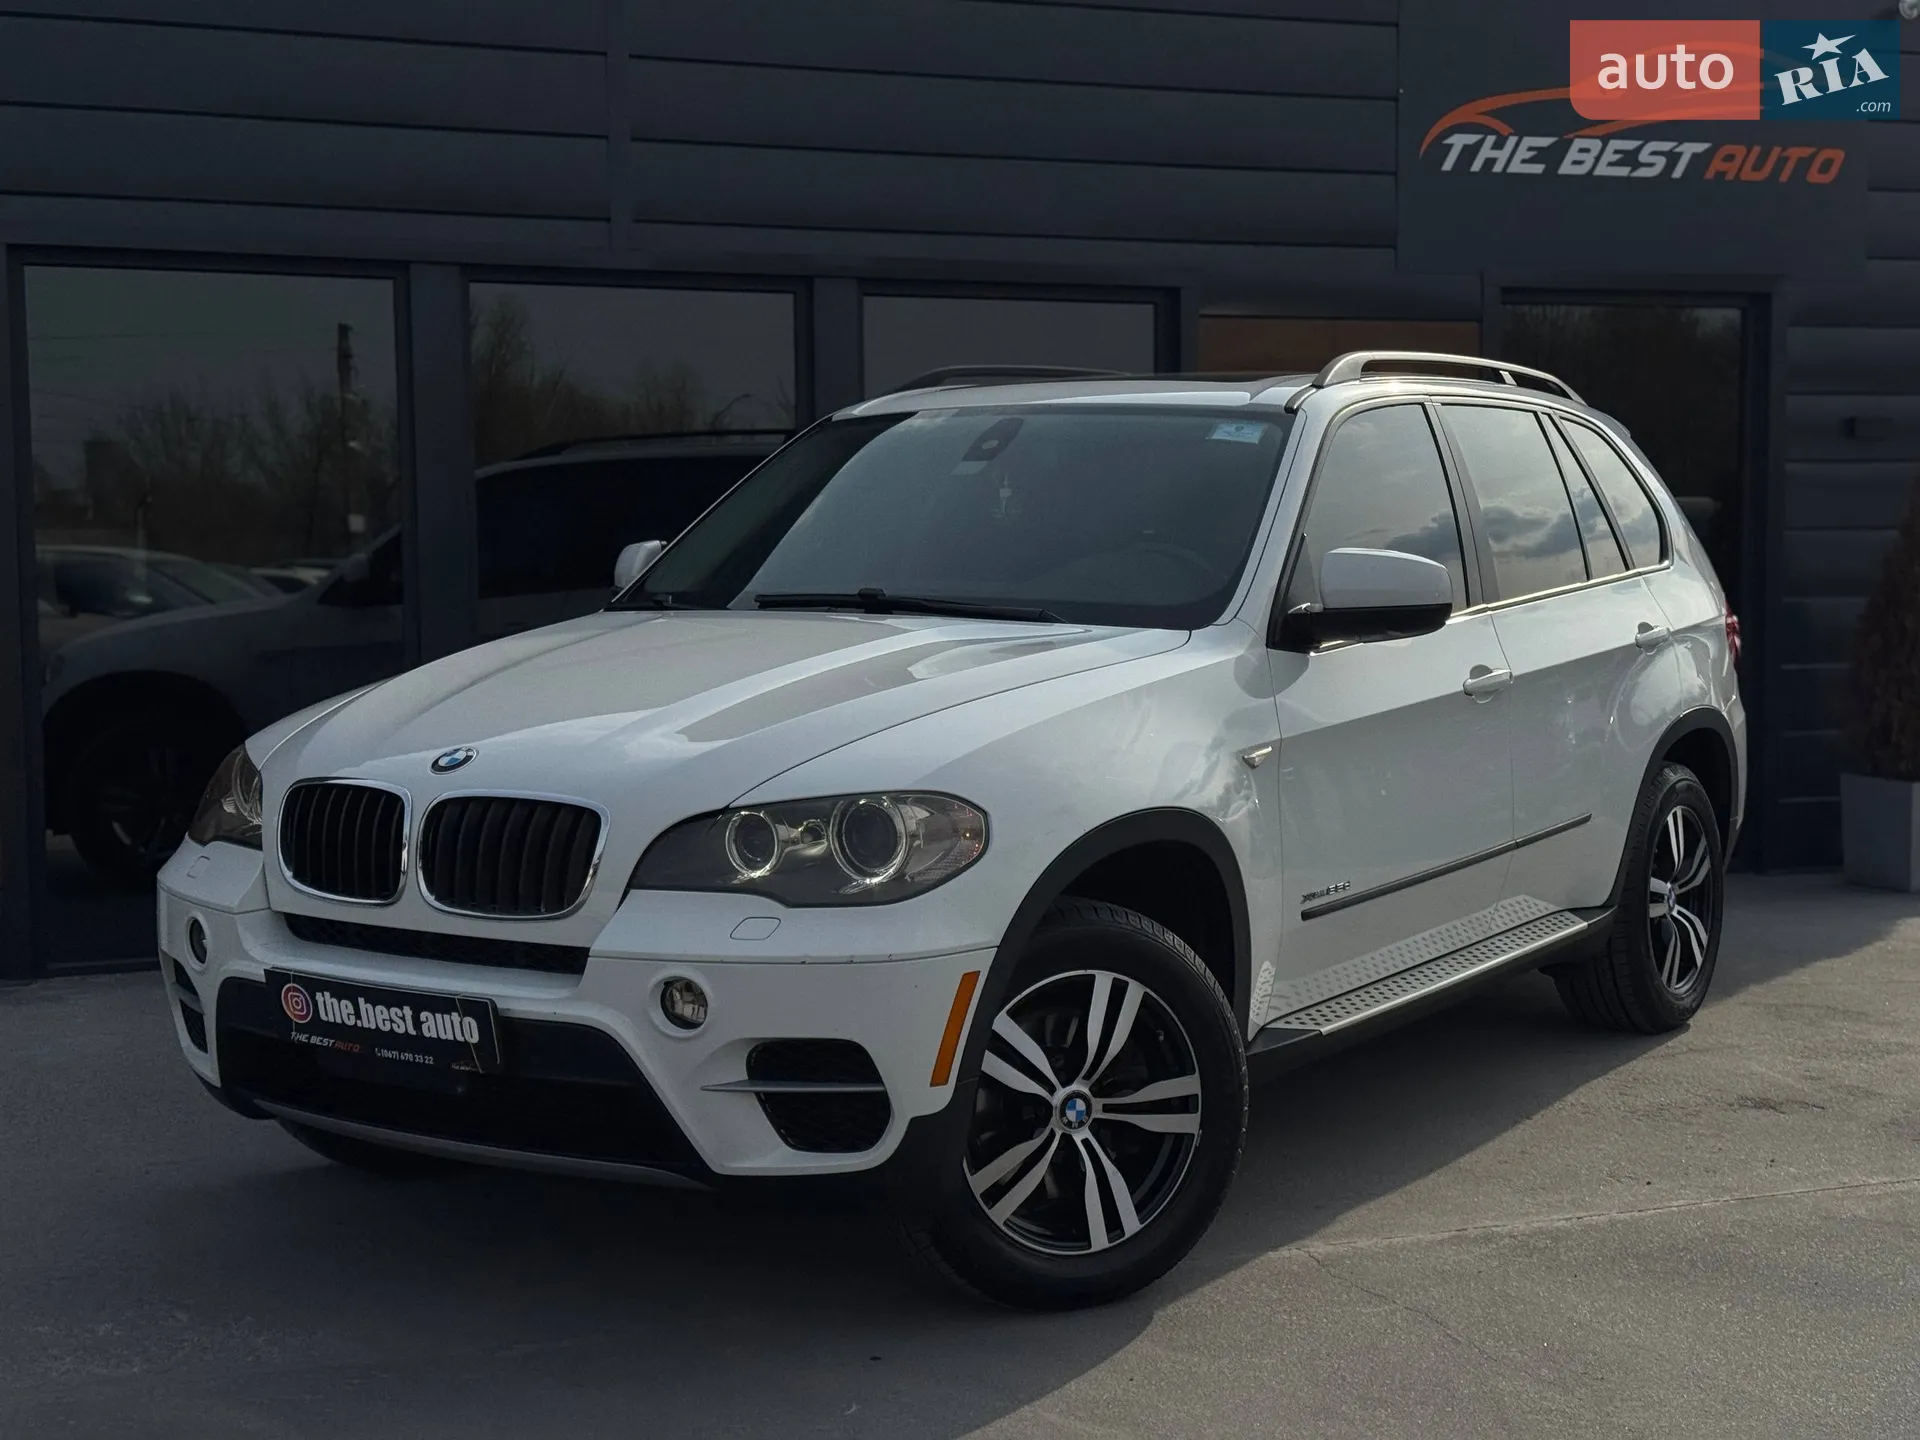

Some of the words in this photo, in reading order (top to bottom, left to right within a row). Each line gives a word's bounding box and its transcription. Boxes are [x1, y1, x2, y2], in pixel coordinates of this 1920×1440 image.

[1441, 133, 1559, 174] THE
[1557, 137, 1712, 179] BEST
[1704, 144, 1845, 184] AUTO
[315, 991, 417, 1036] the.best
[420, 1011, 480, 1044] auto
[290, 1031, 309, 1043] THE
[310, 1035, 335, 1047] BEST
[334, 1041, 360, 1052] AUTO
[424, 1055, 434, 1065] 22
